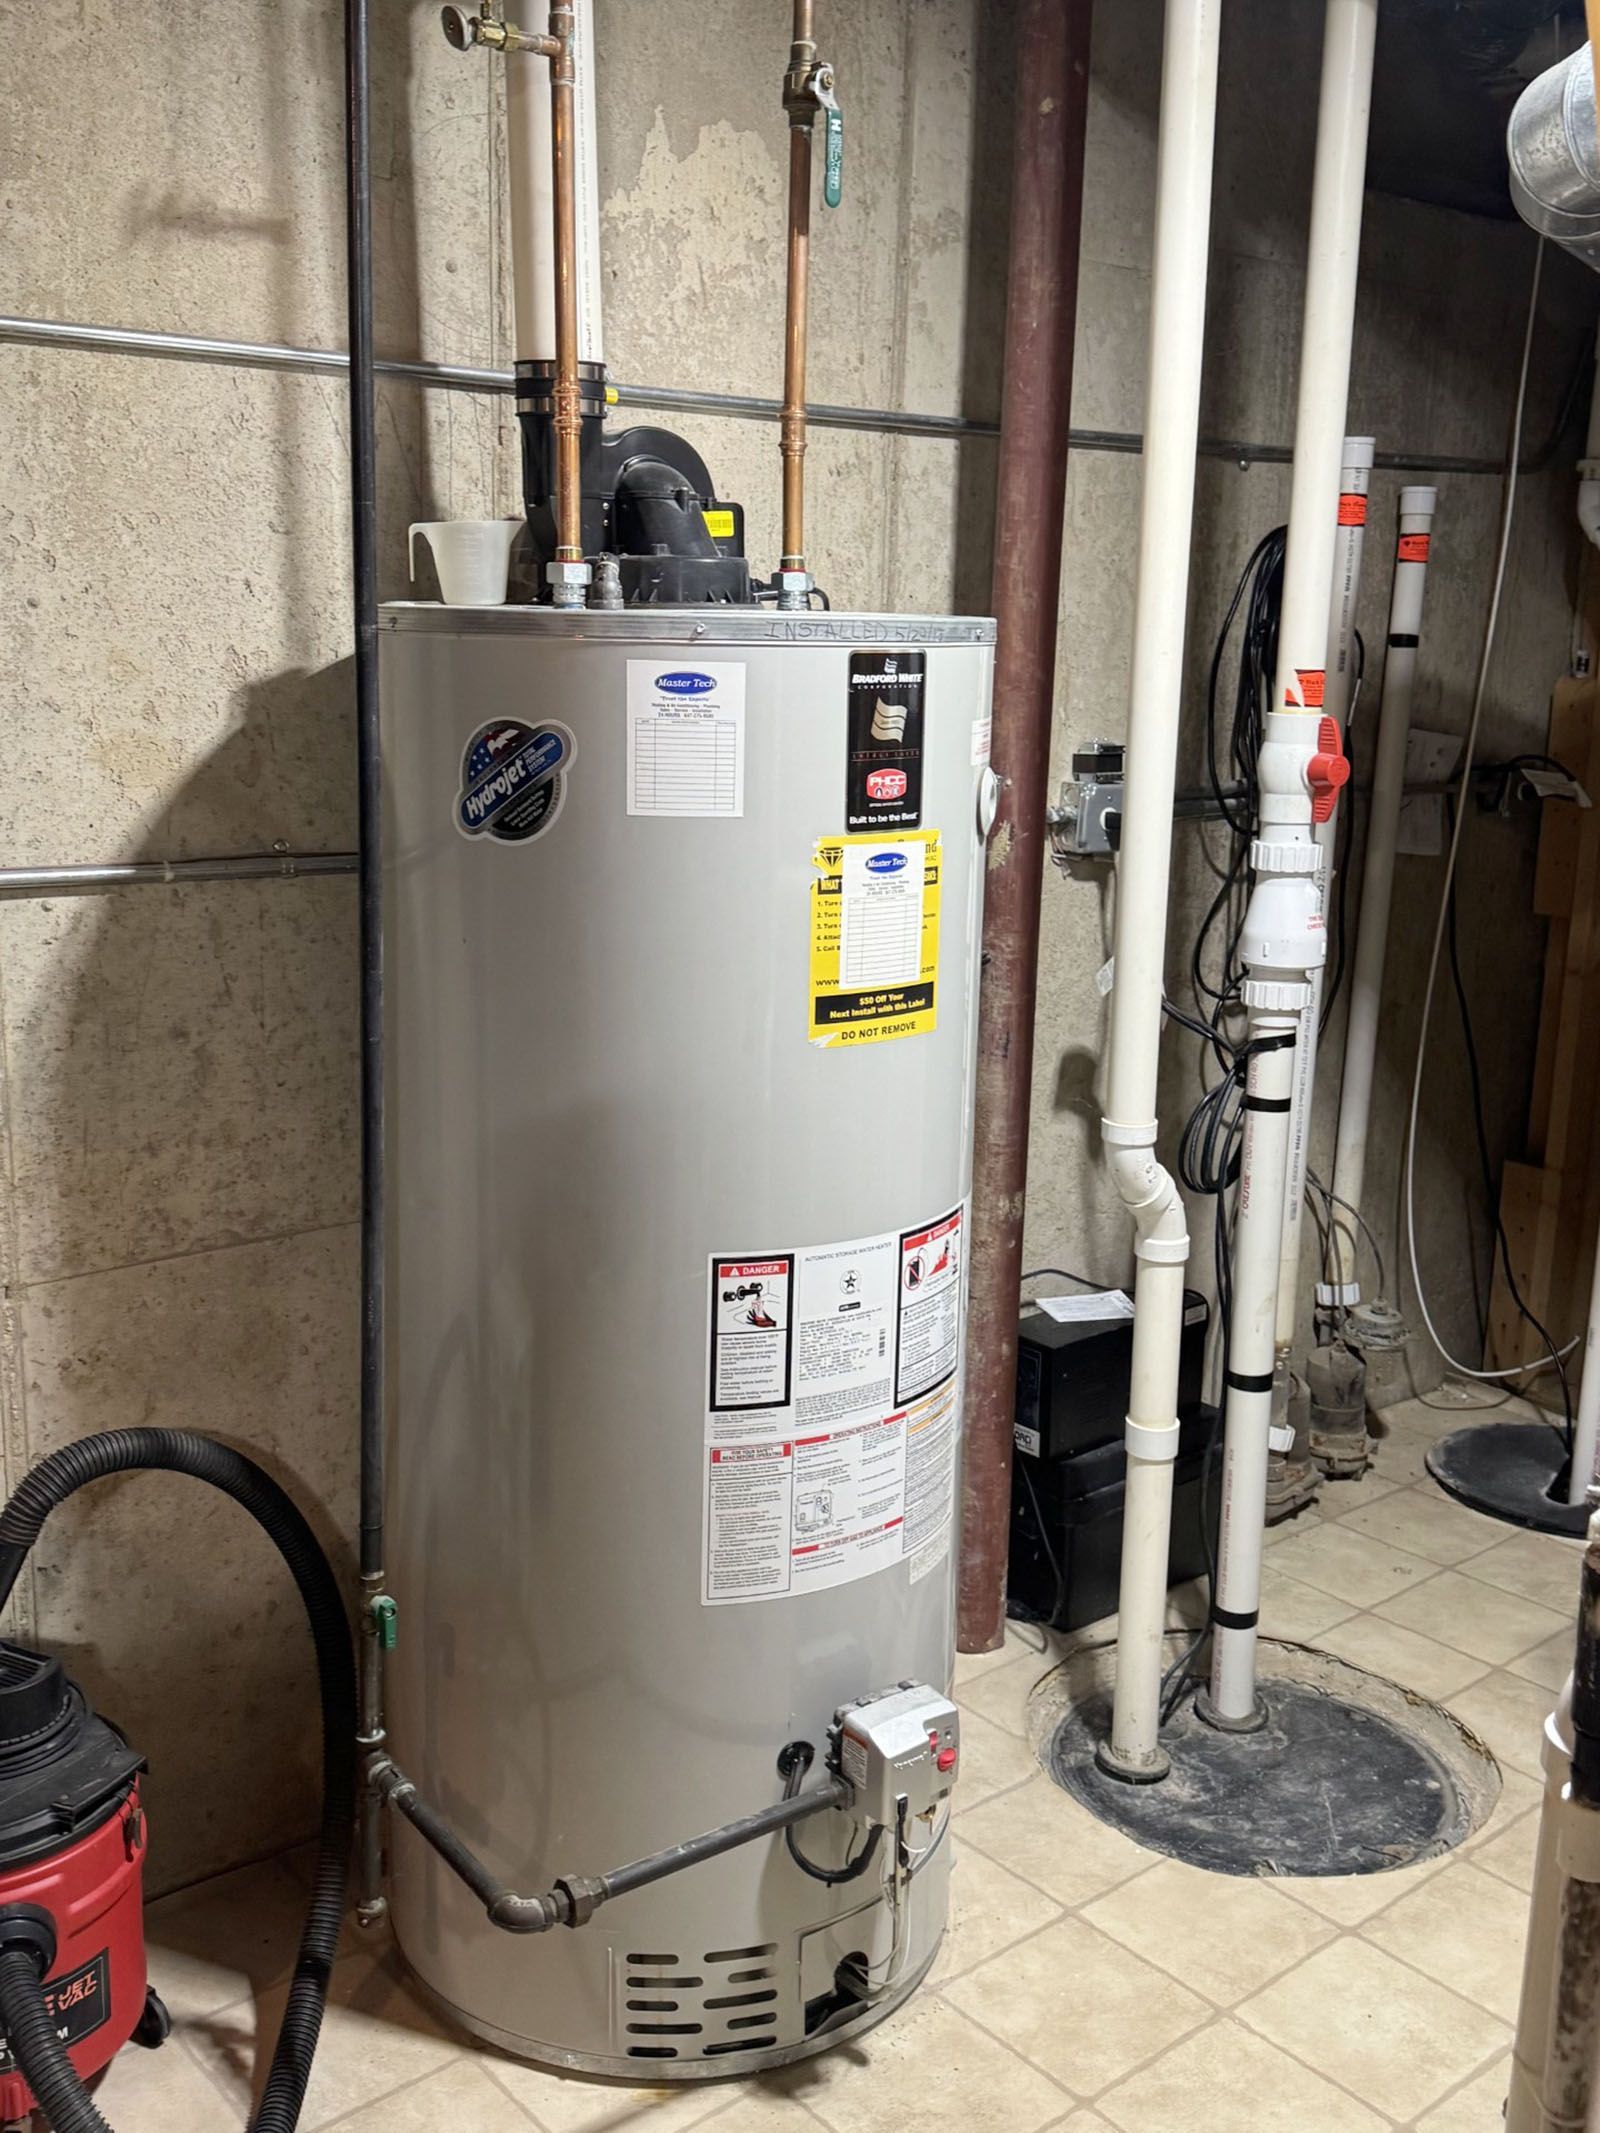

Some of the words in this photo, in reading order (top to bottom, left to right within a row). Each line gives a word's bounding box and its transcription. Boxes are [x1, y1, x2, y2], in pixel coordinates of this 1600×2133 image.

[764, 621, 888, 641] INSTALLED
[658, 678, 691, 688] Master
[693, 678, 716, 688] Tech
[852, 673, 898, 684] BRADFORD
[898, 672, 924, 683] WHITE
[869, 775, 907, 787] PHCC
[466, 757, 526, 820] Hydrojet
[849, 816, 868, 824] Built
[877, 814, 888, 823] be
[889, 813, 900, 821] the
[867, 860, 892, 869] Master
[875, 995, 887, 1004] Off
[888, 993, 904, 1002] Your
[829, 1009, 850, 1019] Next
[851, 1006, 876, 1017] Install
[877, 1004, 894, 1013] with
[894, 1002, 907, 1011] this
[908, 998, 926, 1008] Label
[841, 1030, 856, 1040] DO
[859, 1027, 878, 1038] NOT
[881, 1021, 916, 1035] REMOVE
[742, 1265, 780, 1275] DANGER
[59, 1970, 95, 2000] JET
[58, 1981, 97, 2010] VAC
